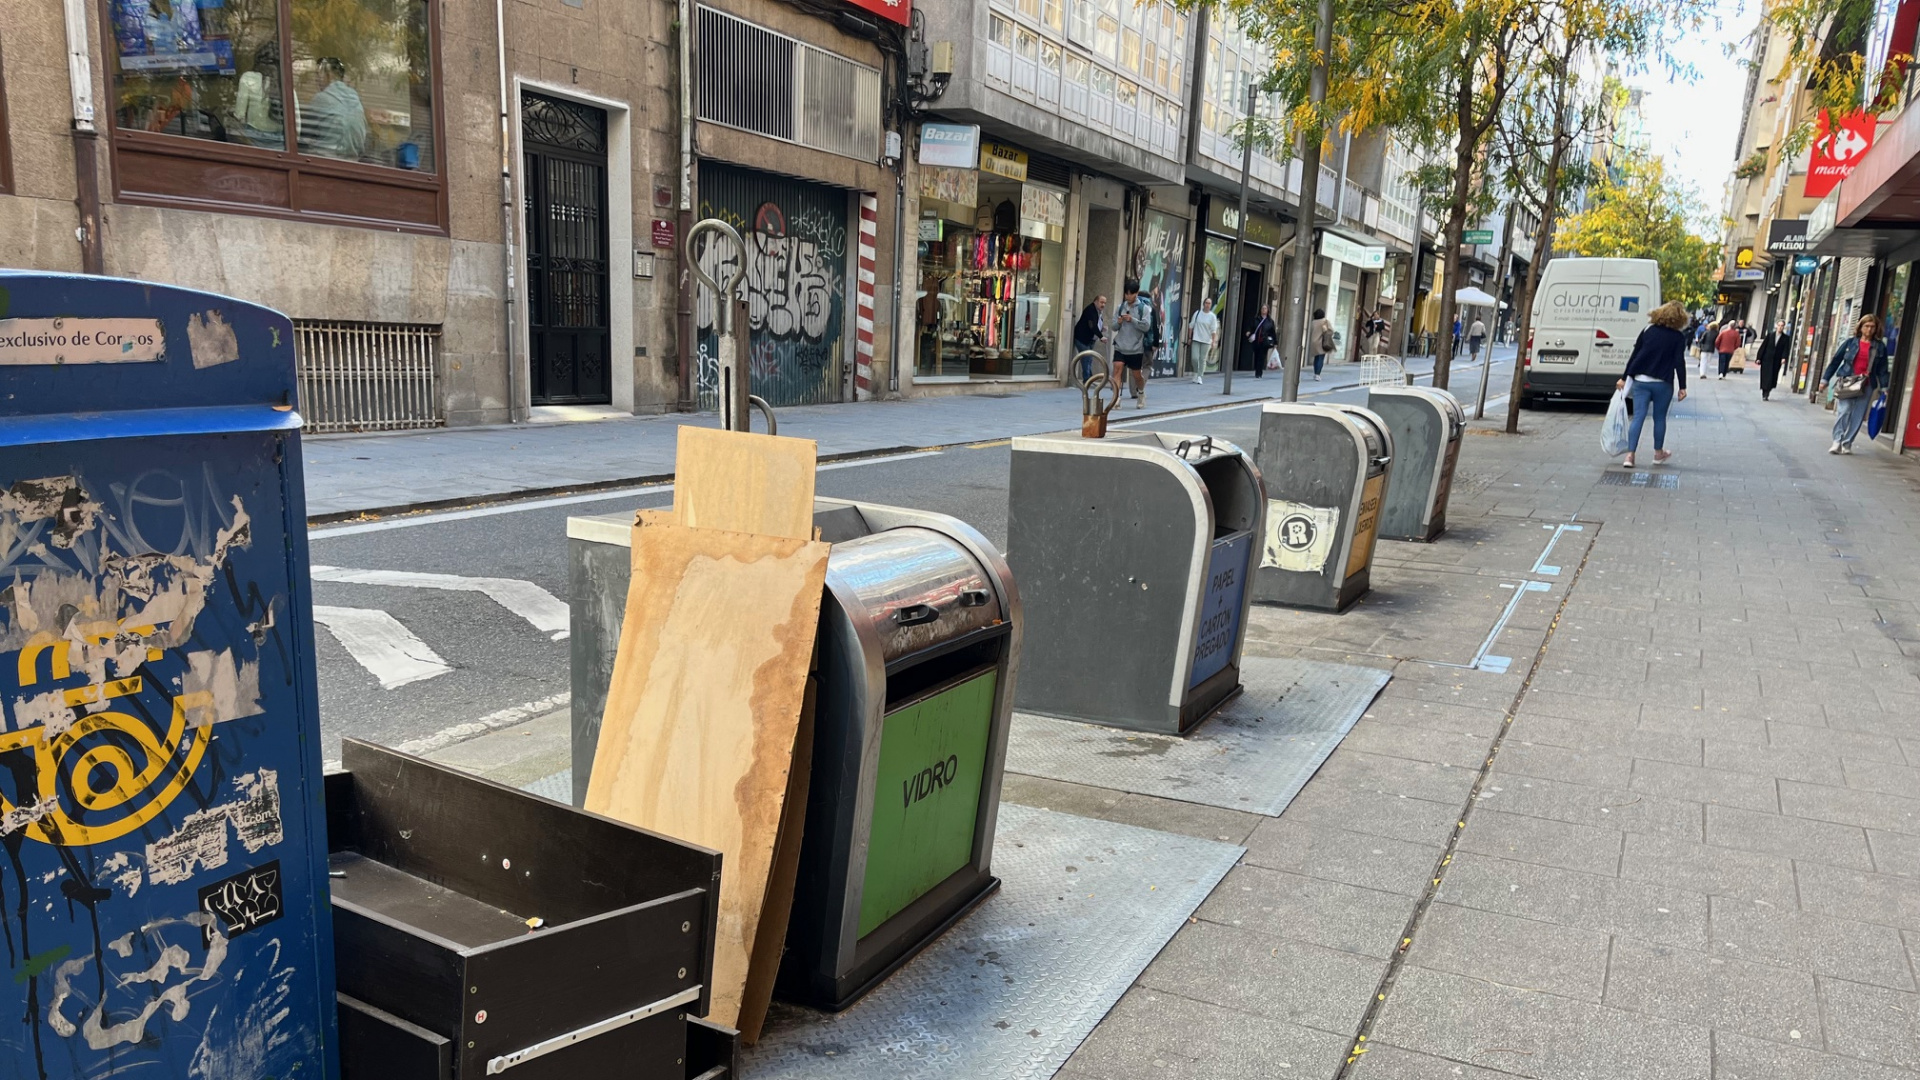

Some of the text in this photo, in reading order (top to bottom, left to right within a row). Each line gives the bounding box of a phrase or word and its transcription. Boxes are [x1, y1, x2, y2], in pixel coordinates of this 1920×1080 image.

[925, 128, 971, 141] Bazar
[991, 144, 1018, 162] Bazar
[1814, 163, 1855, 176] marke
[1769, 242, 1805, 250] AFFLELOU
[1553, 291, 1615, 308] duran
[0, 331, 153, 348] exclusivo de Coros
[1211, 567, 1235, 594] PAPEL
[1200, 605, 1232, 640] CARTÓN
[1193, 628, 1231, 664] PREGADO
[903, 754, 958, 809] VIDRO
